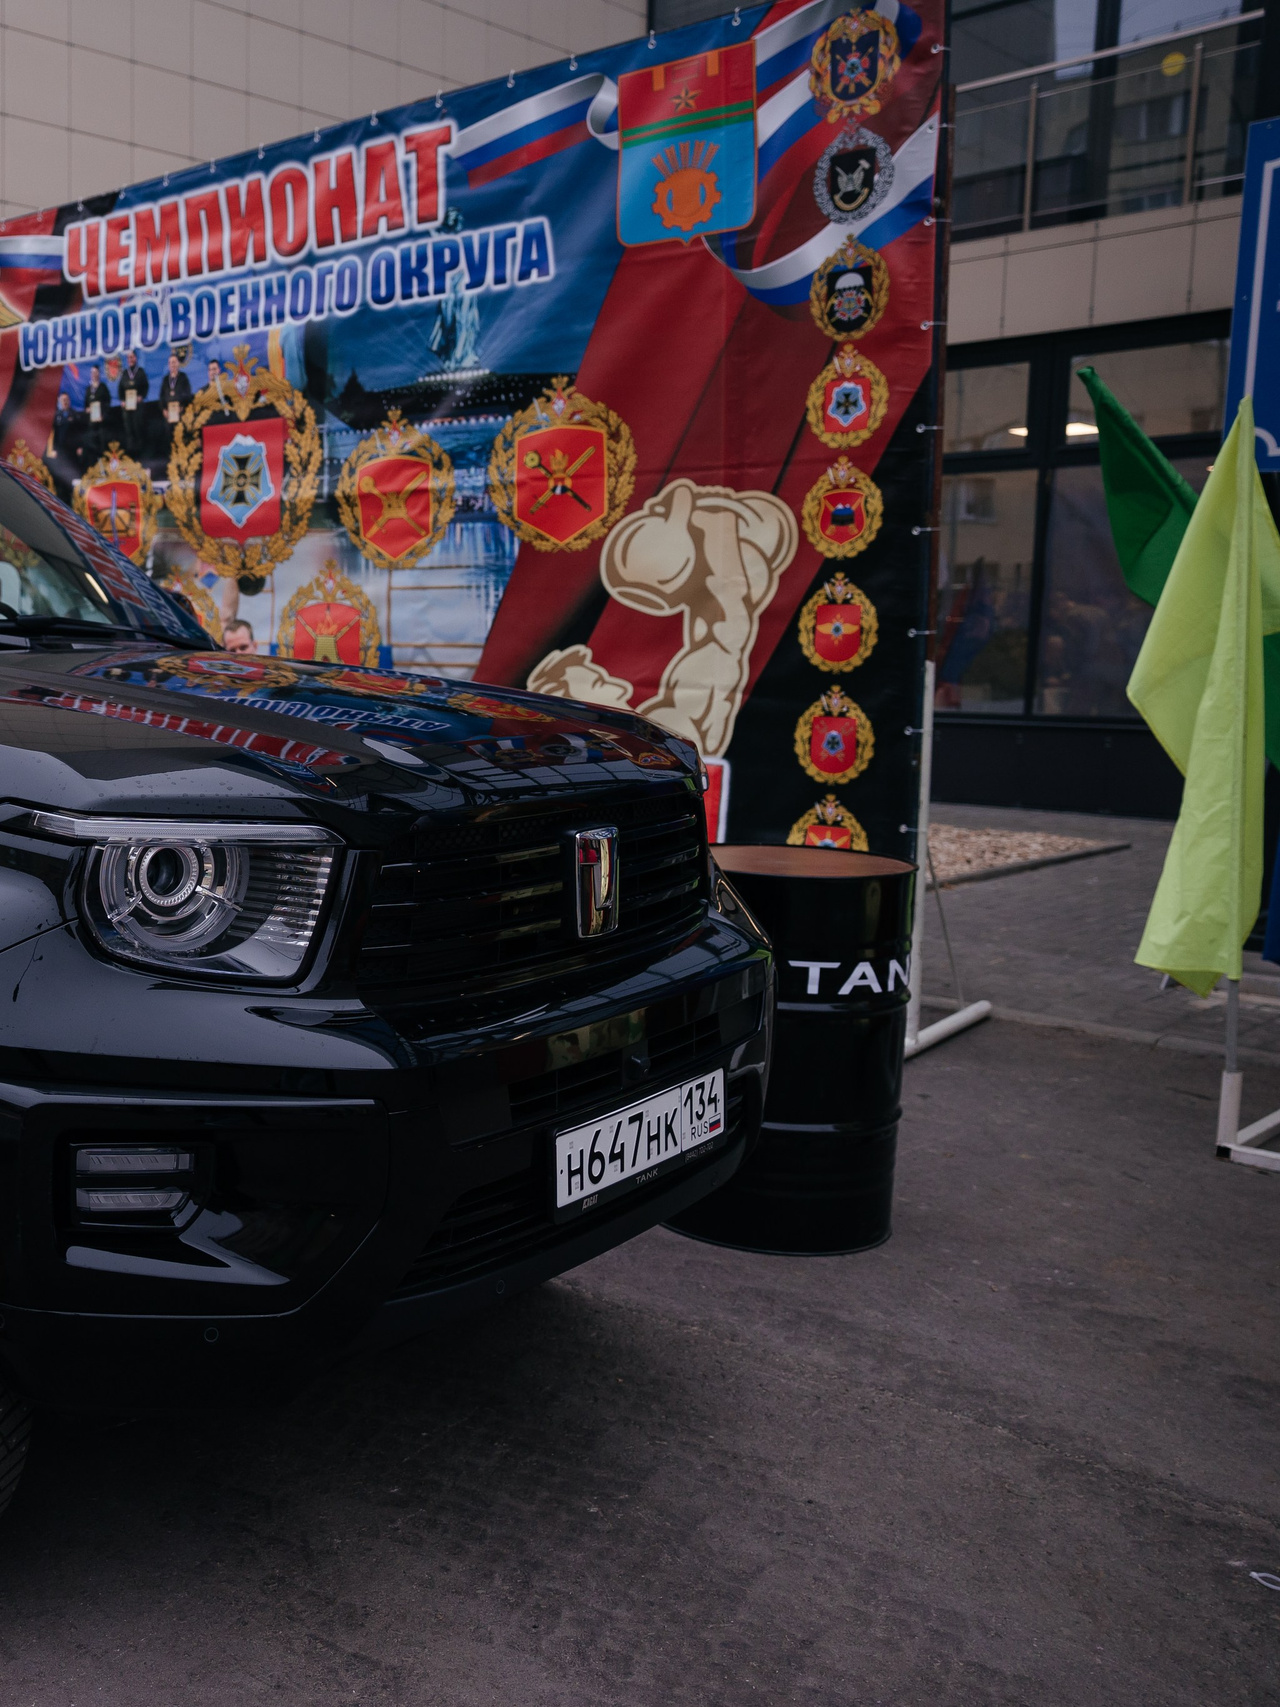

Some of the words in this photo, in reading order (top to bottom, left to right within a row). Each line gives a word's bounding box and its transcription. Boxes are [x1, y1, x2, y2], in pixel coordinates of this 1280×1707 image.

[63, 124, 454, 297] ЧЕМПИОНАТ
[19, 300, 160, 370] ЮЖНОГО
[170, 258, 358, 343] ВОЕННОГО
[370, 219, 552, 302] ОКРУГА
[567, 1107, 678, 1196] Н647НК
[683, 1076, 718, 1125] 134
[635, 1168, 659, 1185] TANK
[690, 1124, 709, 1141] RUS
